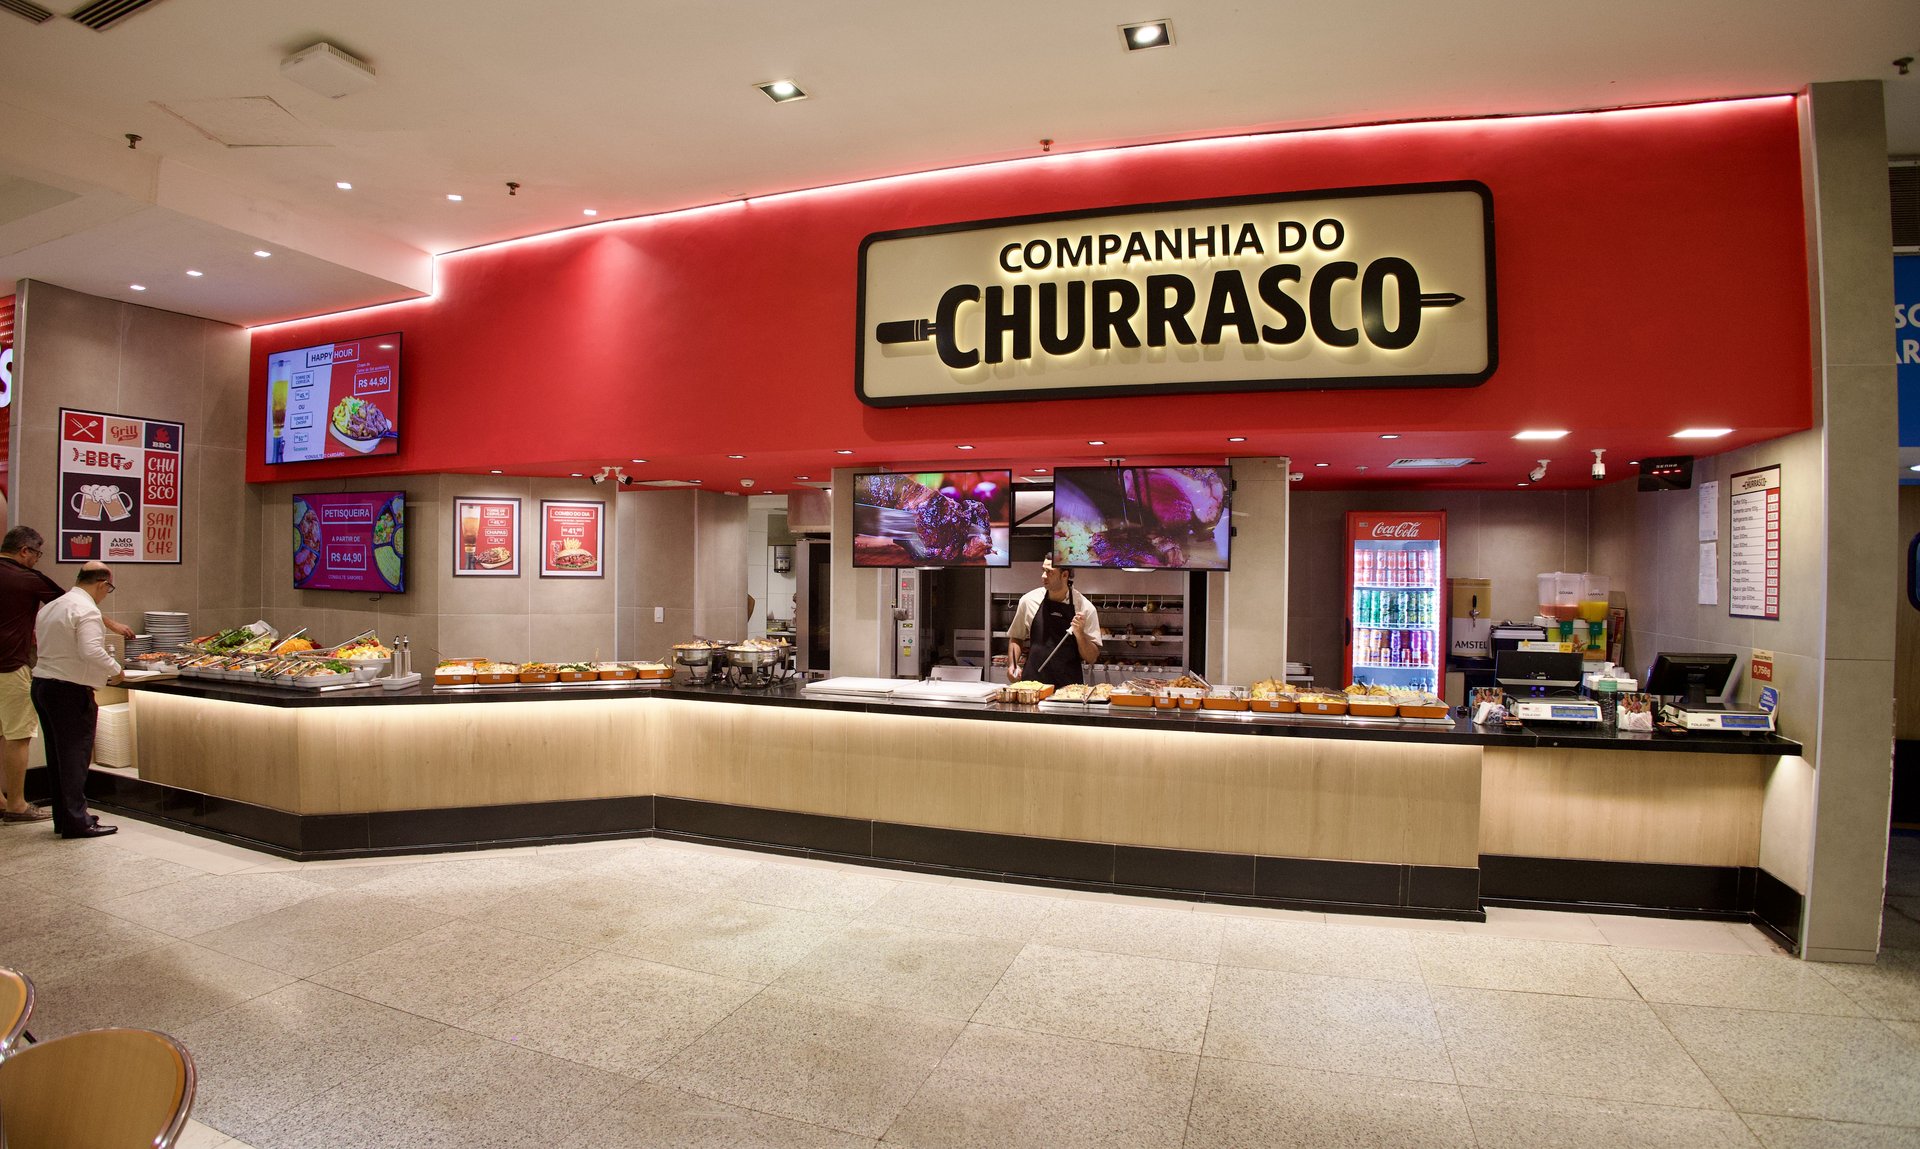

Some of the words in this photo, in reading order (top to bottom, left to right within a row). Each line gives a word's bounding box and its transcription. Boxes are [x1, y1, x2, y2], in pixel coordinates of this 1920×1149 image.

[998, 222, 1264, 274] COMPANHIA
[1277, 218, 1346, 255] DO
[935, 256, 1423, 370] CHURRASCO
[311, 351, 332, 362] HAPPY
[333, 348, 353, 359] HOUR
[1896, 339, 1920, 364] R
[358, 378, 367, 388] R$
[369, 376, 388, 388] 44,90
[110, 425, 138, 440] Grill
[152, 441, 172, 449] BBQ
[86, 450, 121, 470] BBQ
[148, 457, 175, 473] CHU
[148, 472, 174, 486] RRA
[147, 485, 175, 500] SCO
[147, 513, 174, 527] SAN
[324, 508, 370, 519] PETISQUEIRA
[147, 526, 171, 541] DUI
[1372, 521, 1422, 538] Coca-Cola
[336, 535, 353, 543] PARTIR
[353, 535, 360, 543] DE
[146, 540, 173, 554] CHE
[331, 552, 340, 562] R$
[342, 552, 362, 564] 44,90
[1454, 640, 1488, 649] AMSTEL
